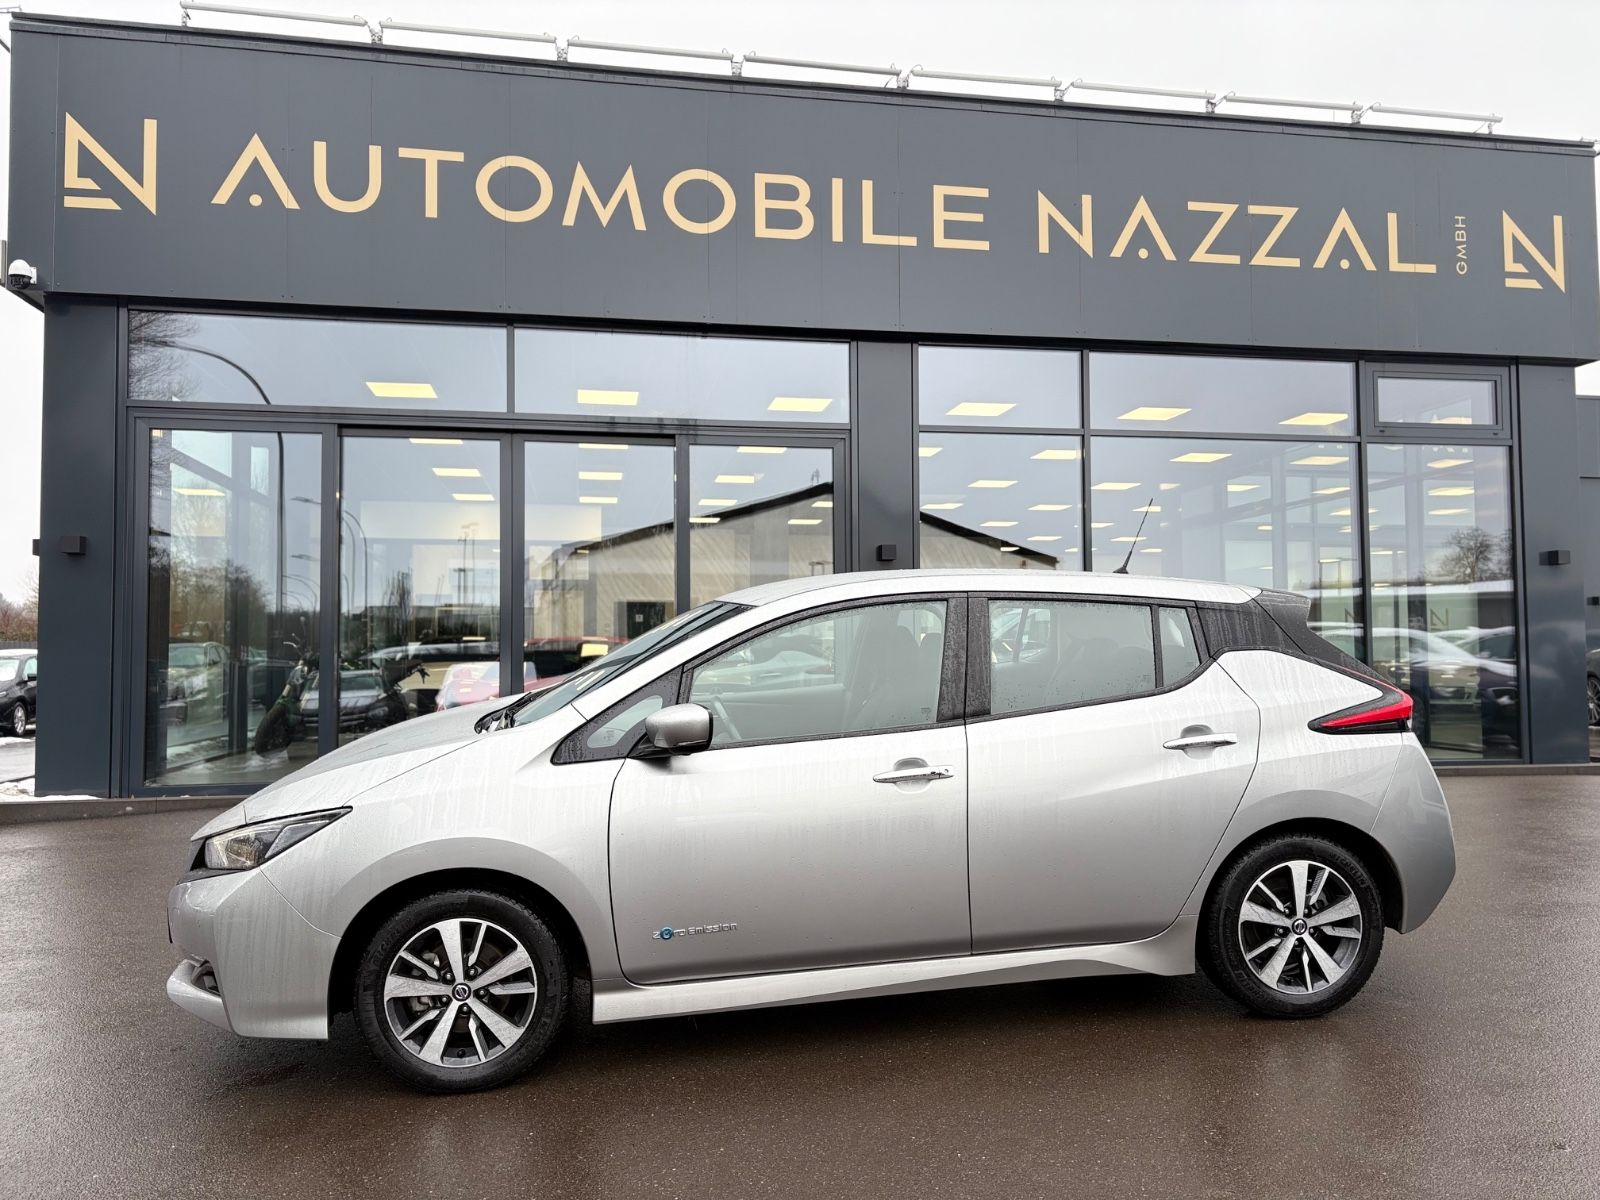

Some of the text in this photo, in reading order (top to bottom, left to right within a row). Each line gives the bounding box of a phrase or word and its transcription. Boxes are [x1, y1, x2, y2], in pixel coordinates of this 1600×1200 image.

[212, 134, 1437, 277] AUTOMOBILE NAZZAL
[1454, 215, 1468, 275] GMBH
[688, 922, 738, 935] Emission
